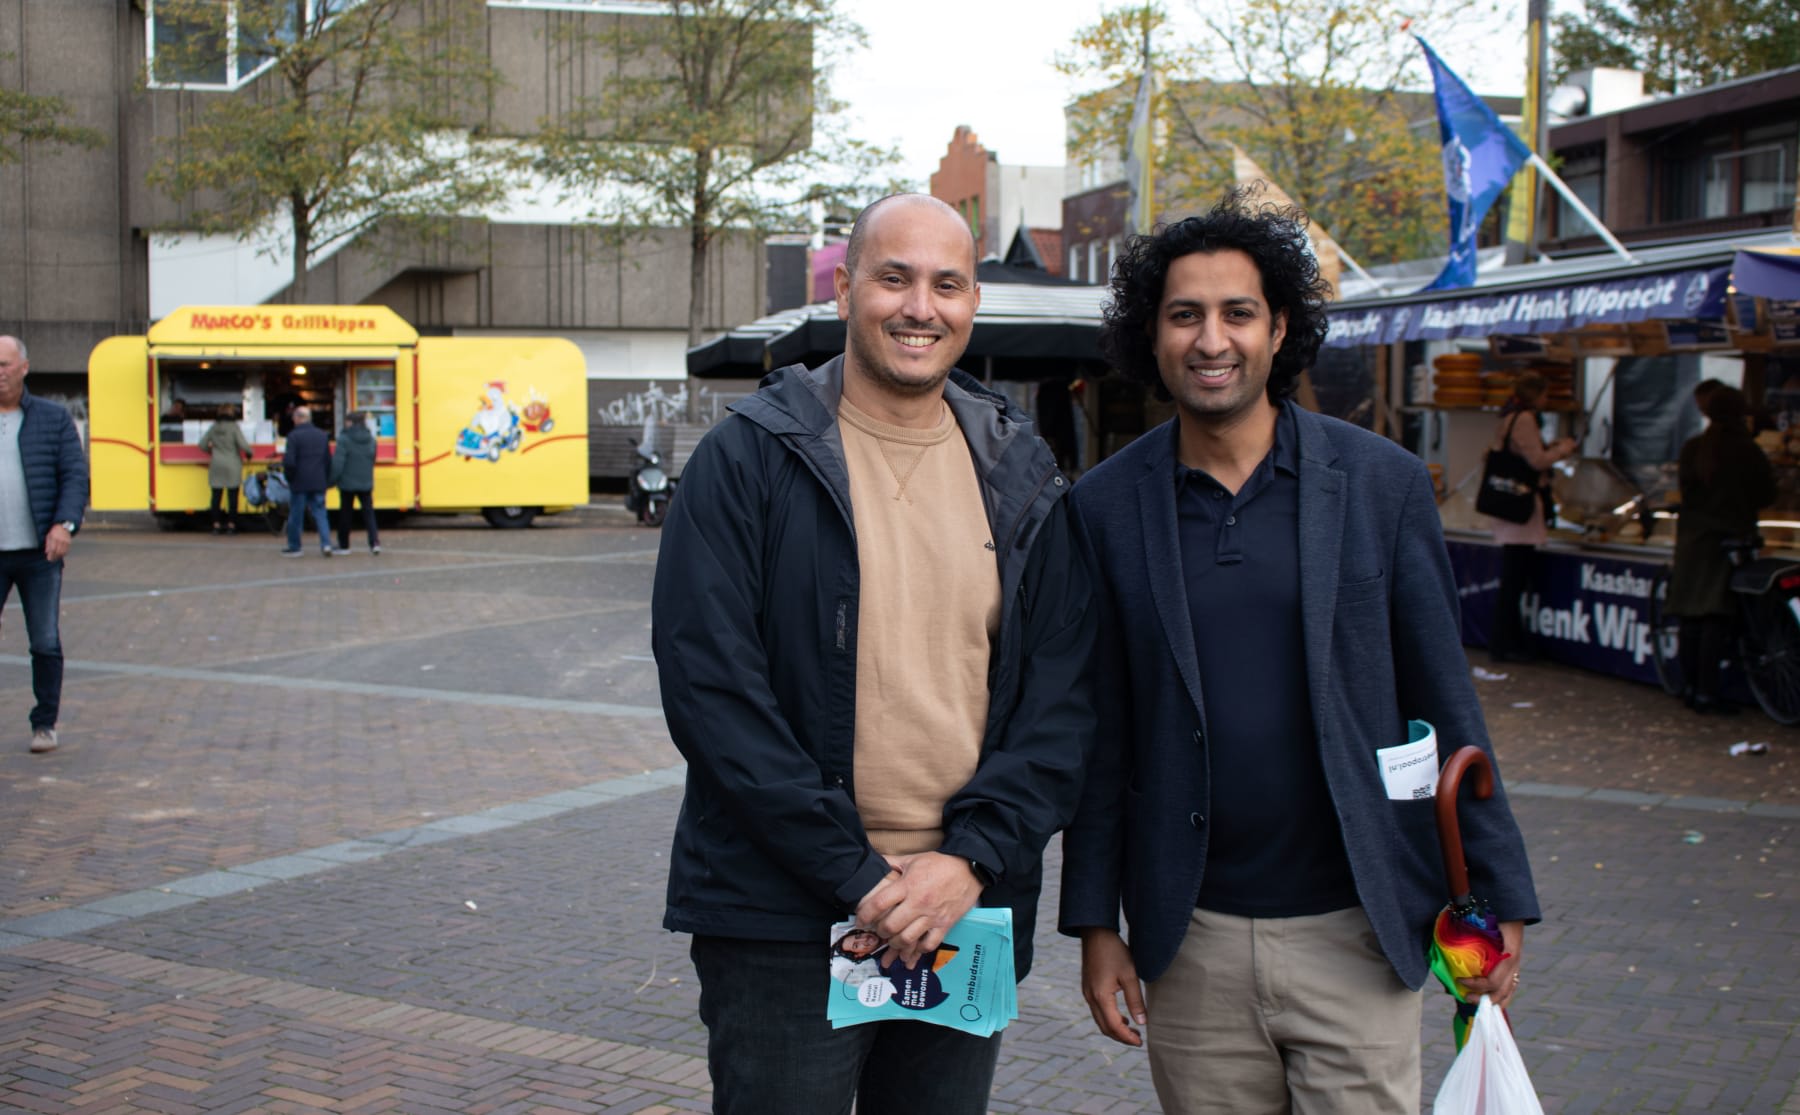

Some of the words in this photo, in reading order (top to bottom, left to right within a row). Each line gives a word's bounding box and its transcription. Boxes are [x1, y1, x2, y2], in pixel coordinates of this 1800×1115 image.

[1515, 289, 1569, 322] Hnk
[1520, 592, 1591, 643] Henk
[918, 969, 928, 1007] bewoners
[967, 944, 982, 1001] ombudsman
[902, 979, 912, 1005] Samen
